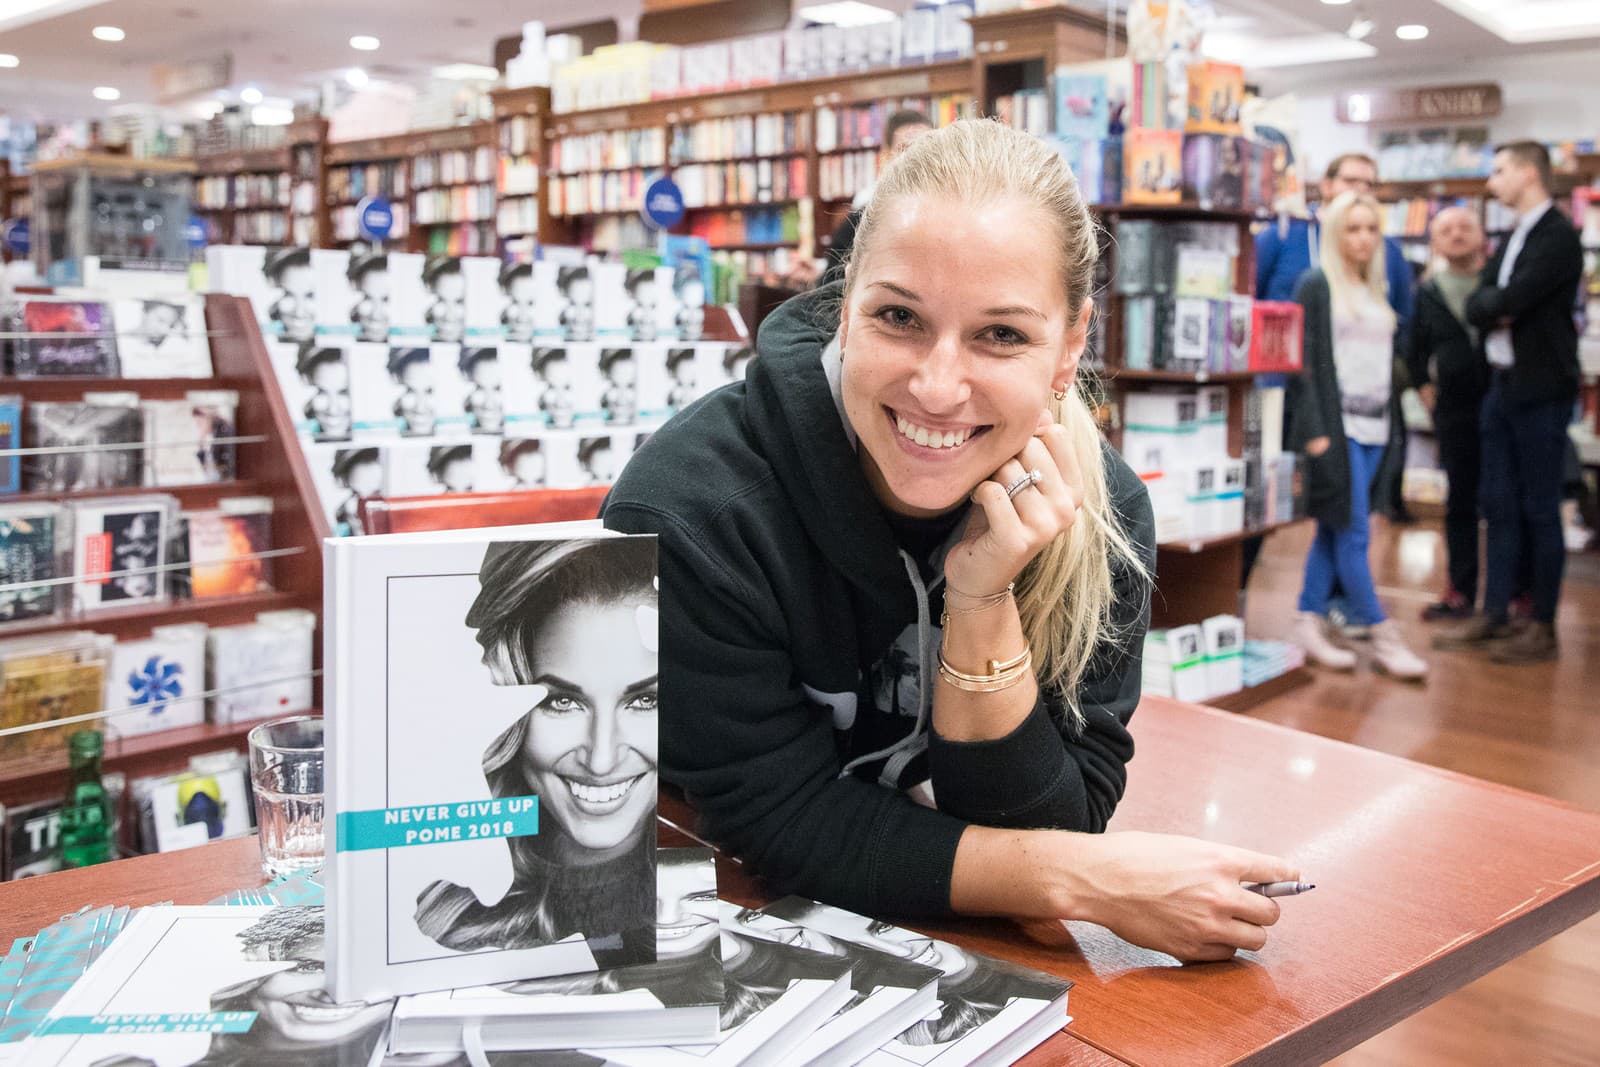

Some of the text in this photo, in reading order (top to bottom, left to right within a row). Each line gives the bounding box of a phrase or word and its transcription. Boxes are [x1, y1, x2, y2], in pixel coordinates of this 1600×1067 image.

[384, 798, 534, 825] NEVER GIVE UP
[405, 821, 514, 844] POME 2018
[90, 1012, 252, 1025] NEVER GIVE UP
[103, 1023, 224, 1034] POME 2018
